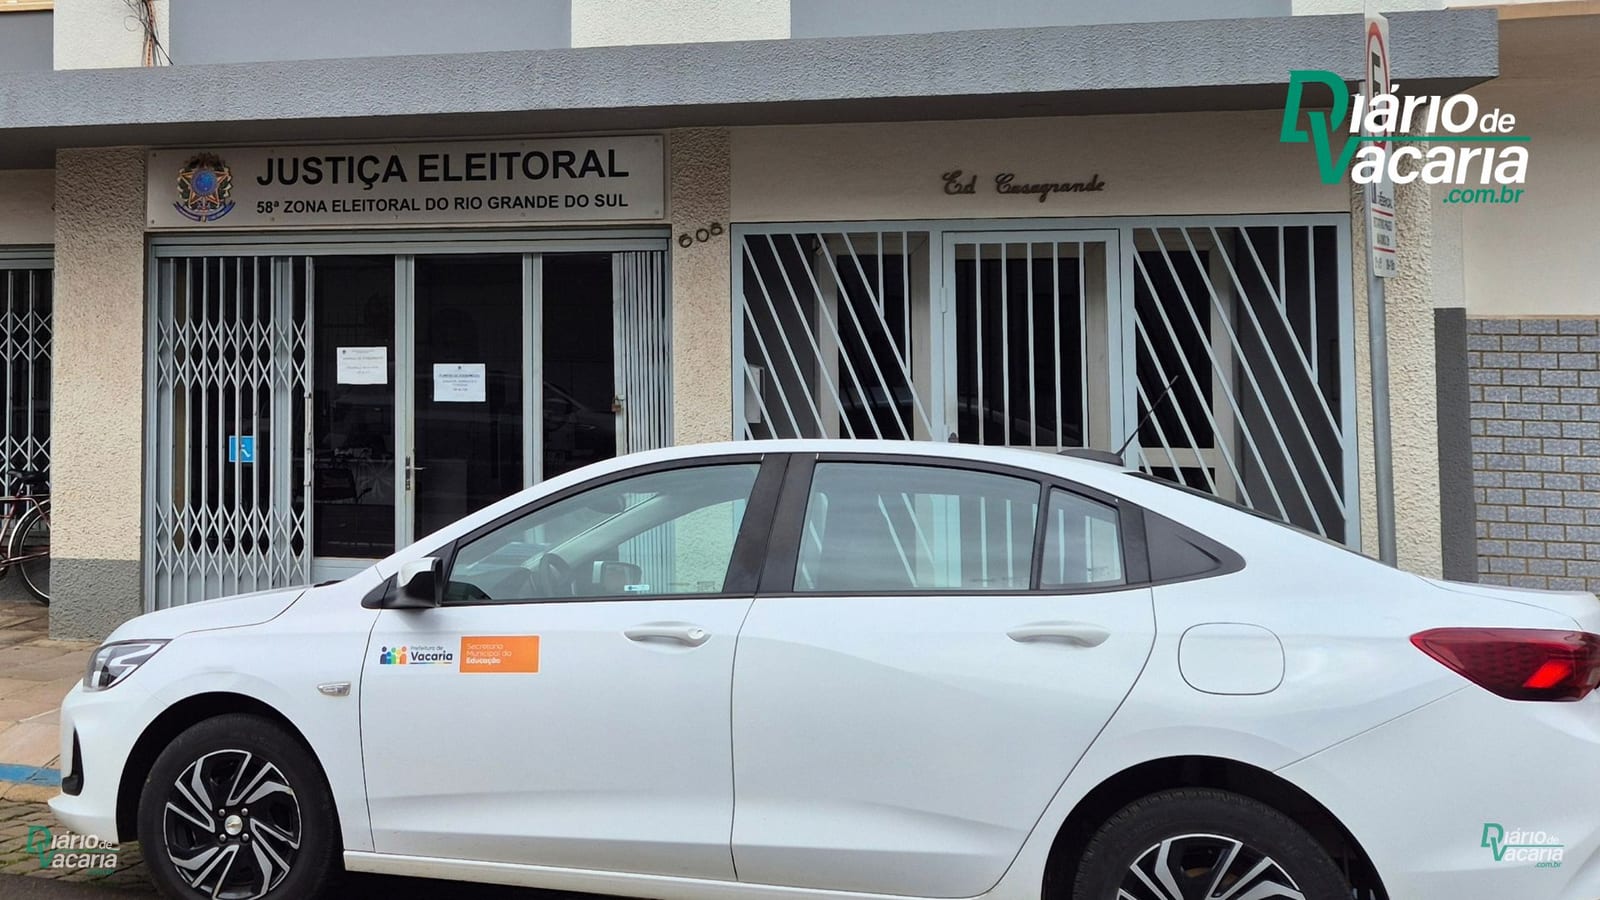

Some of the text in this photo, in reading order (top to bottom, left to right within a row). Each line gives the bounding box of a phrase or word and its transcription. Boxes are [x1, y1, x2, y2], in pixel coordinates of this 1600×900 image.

[256, 149, 630, 190] JUSTIÇA ELEITORAL
[942, 170, 1106, 203] Ed Casagrande
[256, 193, 629, 214] 58ª ZONA ELEITORAL DO RIO GRANDE DO SUL
[411, 650, 453, 661] Vacaria
